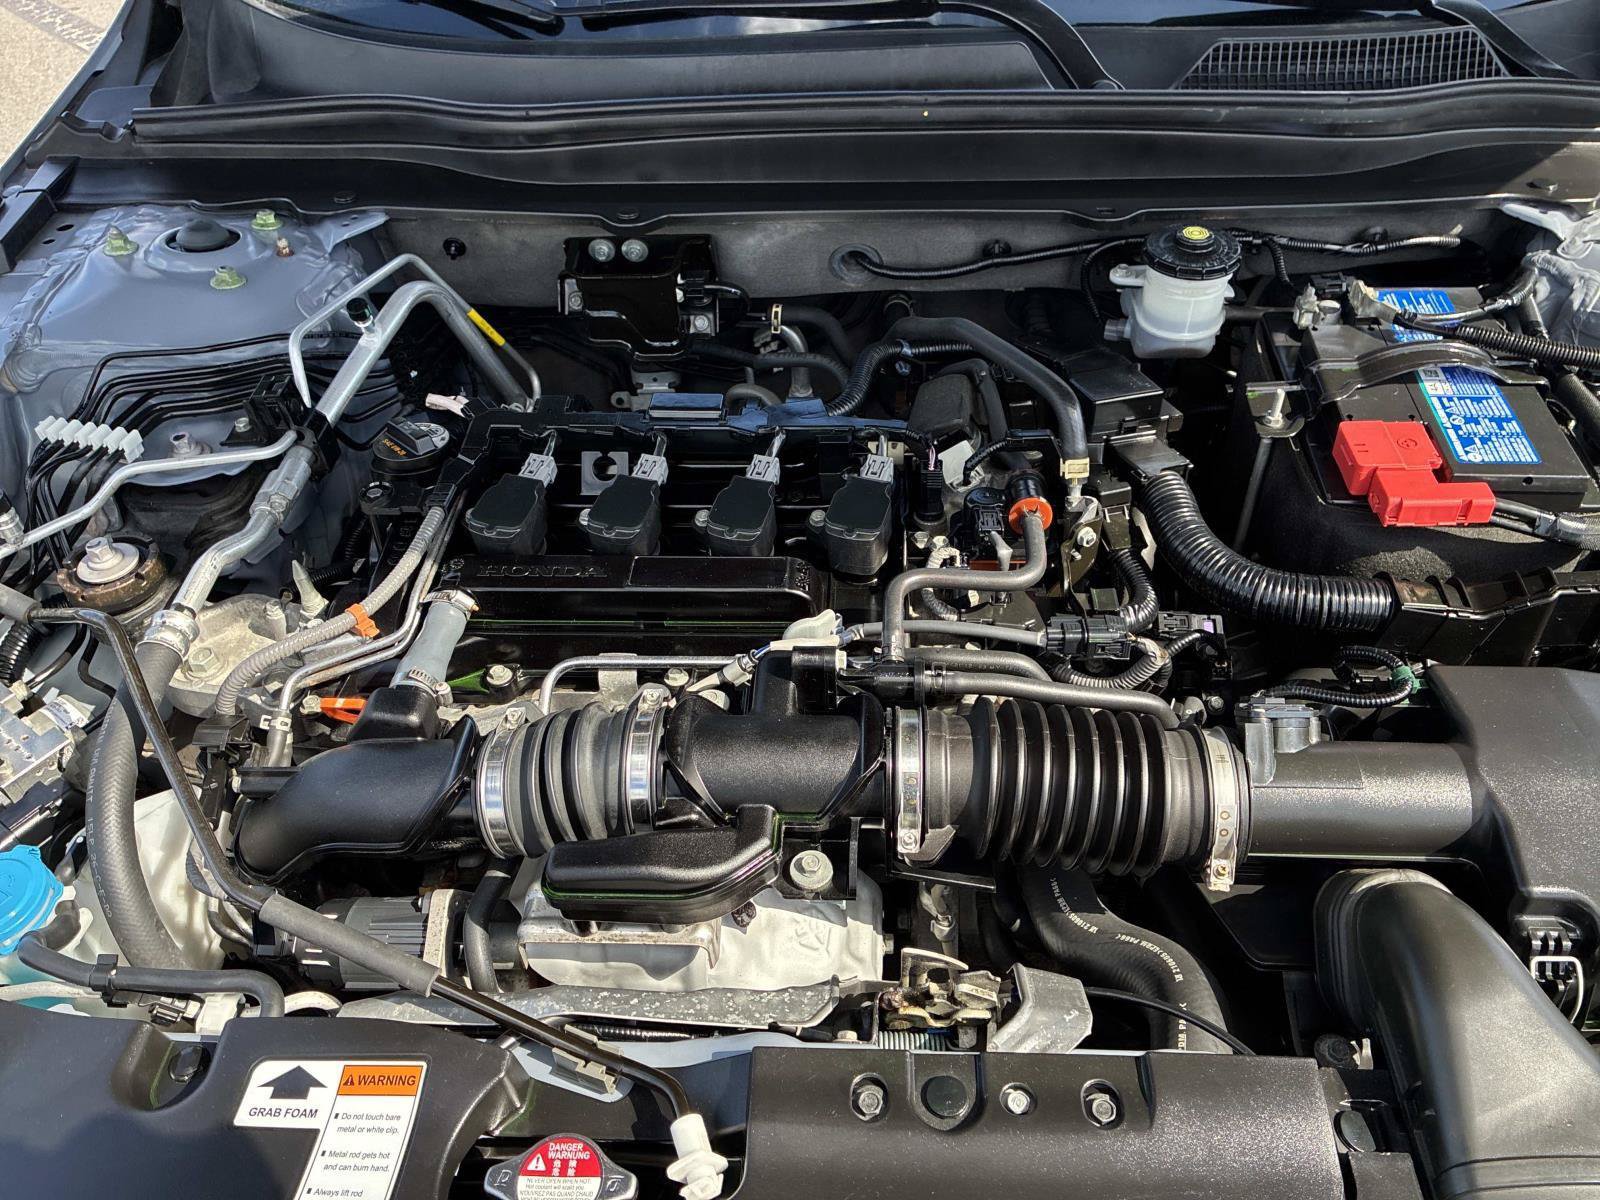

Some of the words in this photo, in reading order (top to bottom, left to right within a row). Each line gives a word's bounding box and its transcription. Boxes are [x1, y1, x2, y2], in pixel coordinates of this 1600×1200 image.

[476, 564, 608, 577] HONDA
[357, 1075, 416, 1086] WARNING
[248, 1107, 282, 1117] GRAB
[284, 1108, 318, 1118] FOAM
[365, 1113, 382, 1121] touch
[383, 1113, 401, 1121] bare
[366, 1126, 385, 1134] white
[385, 1126, 400, 1136] clip.
[549, 1142, 583, 1151] DANGER
[348, 1151, 361, 1159] rod
[361, 1152, 377, 1161] gets
[548, 1151, 591, 1160] WARNUNG
[353, 1164, 369, 1172] burn
[370, 1164, 390, 1172] hand.
[313, 1189, 339, 1197] Always
[340, 1189, 351, 1197] lift
